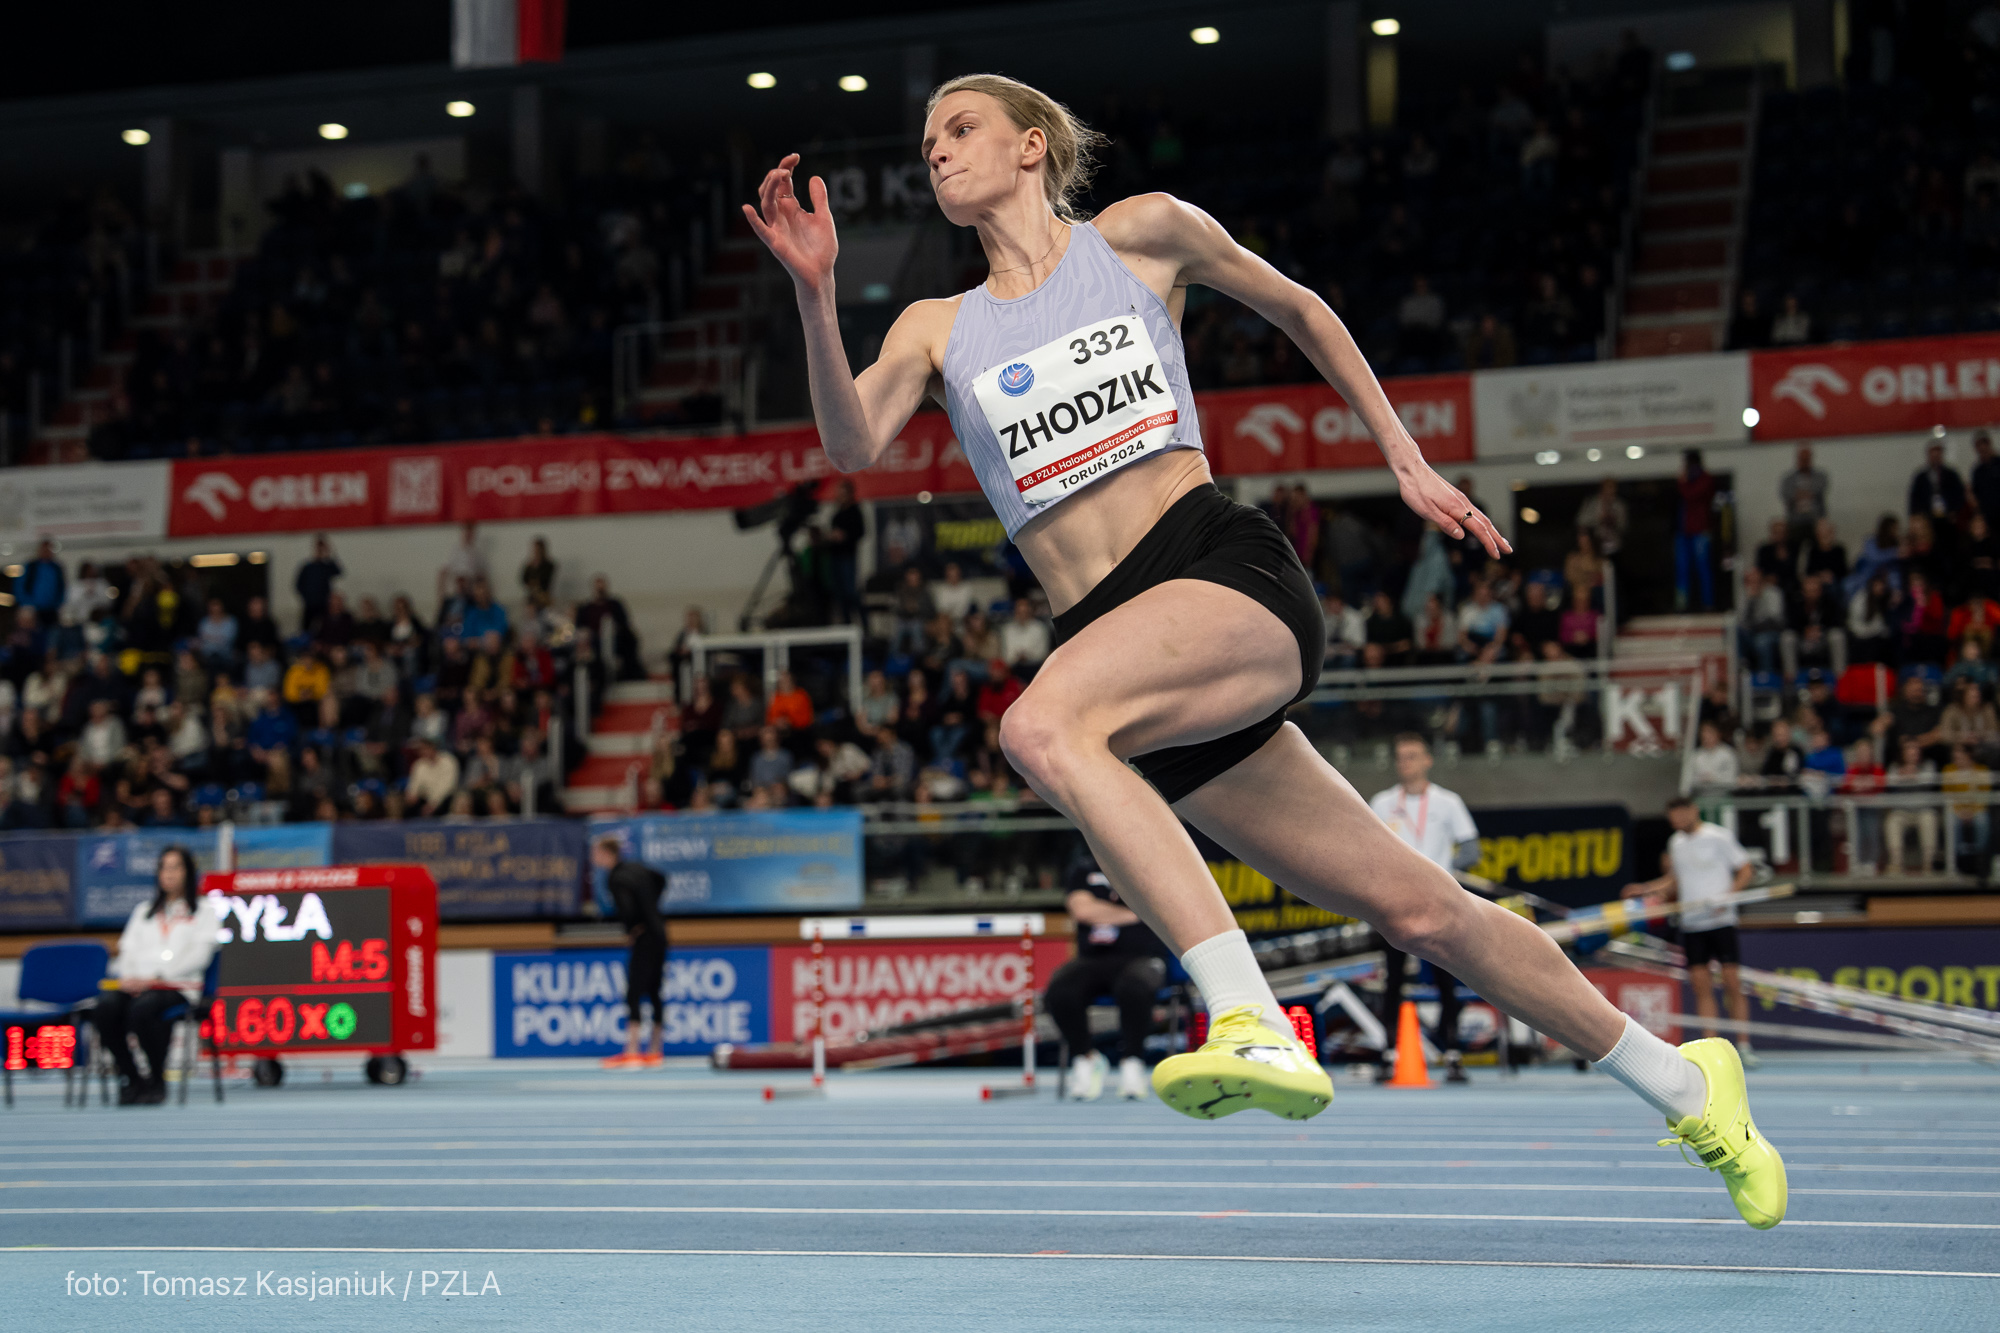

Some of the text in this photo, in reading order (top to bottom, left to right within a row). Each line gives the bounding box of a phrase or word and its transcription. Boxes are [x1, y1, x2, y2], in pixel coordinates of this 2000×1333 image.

[1069, 324, 1135, 365] 332
[999, 364, 1165, 460] ZHODZIK
[1022, 412, 1175, 488] 68. PZLA Halowe Mistrzostwa Polski
[1059, 439, 1146, 490] TORUŃ 2024
[248, 471, 369, 512] ORLEN
[466, 460, 601, 496] POLSKI
[1604, 682, 1682, 742] K1
[311, 938, 390, 982] M:5
[792, 953, 1028, 998] KUJAWSKO
